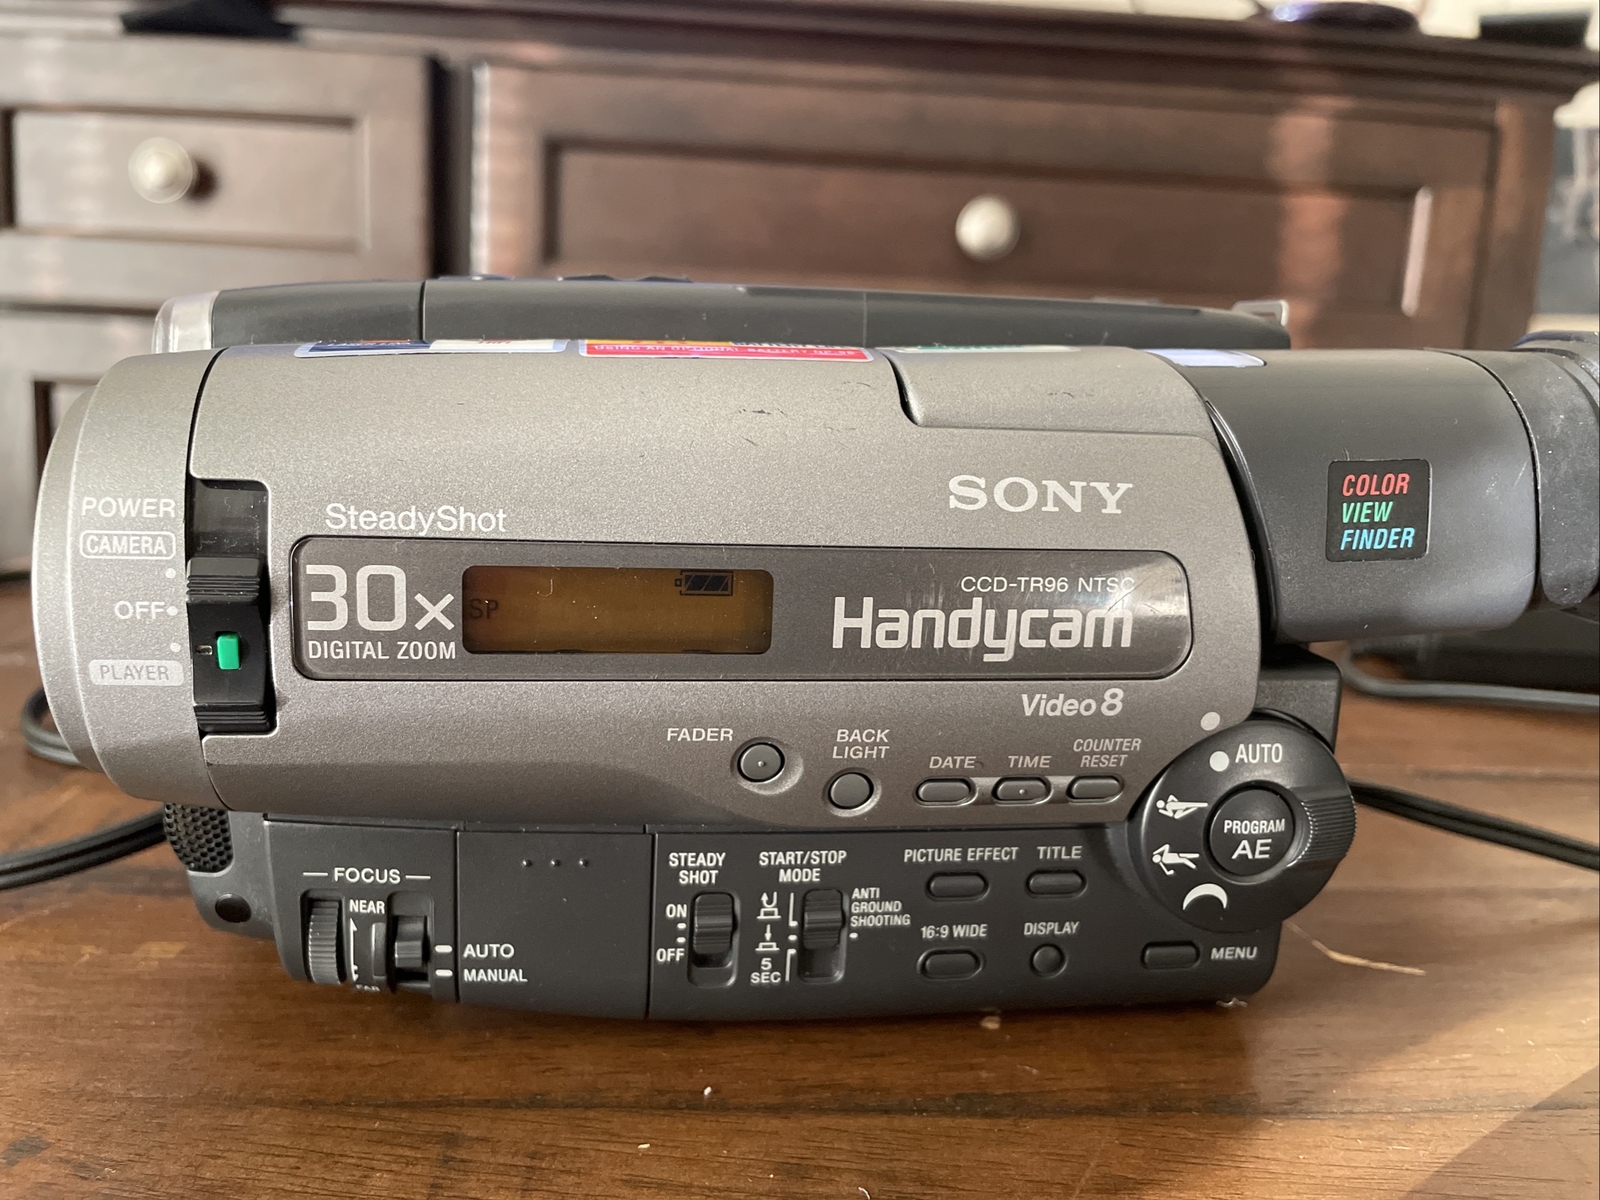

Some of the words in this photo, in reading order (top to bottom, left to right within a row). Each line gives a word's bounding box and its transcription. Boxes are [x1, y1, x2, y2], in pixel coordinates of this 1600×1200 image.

[1342, 473, 1410, 497] COLOR
[948, 475, 1134, 514] SONY
[81, 496, 177, 518] POWER
[1342, 501, 1393, 523] VIEW
[325, 502, 507, 536] SteadyShot
[86, 535, 167, 555] CAMERA
[1340, 527, 1415, 550] FINDER
[960, 576, 1069, 593] CCD-TR96
[1078, 577, 1135, 593] NTSC
[114, 601, 166, 620] OFF
[469, 598, 499, 620] SP
[832, 596, 1134, 662] Handycam
[308, 640, 390, 660] DIGITAL
[397, 641, 457, 660] ZOOM
[99, 665, 170, 681] PLAYER
[666, 727, 734, 742] FADER
[836, 728, 890, 743] BACK
[832, 745, 890, 760] LIGHT
[1072, 738, 1142, 752] COUNTER
[1080, 754, 1128, 768] RESET
[1235, 743, 1284, 764] AUTO
[929, 755, 977, 769] DATE
[1007, 755, 1051, 769] TIME
[1223, 819, 1286, 835] PROGRAM
[904, 848, 963, 863] PICTURE
[967, 847, 1019, 861] EFFECT
[1037, 846, 1083, 861] TITLE
[1231, 838, 1273, 860] AE
[668, 852, 726, 868] STEADY
[758, 850, 848, 867] START/STOP
[334, 867, 401, 885] FOCUS
[678, 869, 719, 885] SHOT
[778, 868, 821, 883] MODE
[852, 887, 880, 900] ANTI
[349, 899, 385, 915] NEAR
[665, 904, 688, 919] ON
[851, 901, 902, 914] GROUND
[850, 914, 912, 928] SHOOTING
[920, 925, 950, 940] 16:9
[952, 924, 988, 938] WIDE
[1023, 922, 1080, 937] DISPLAY
[463, 943, 515, 959] AUTO
[656, 948, 685, 963] OFF
[1210, 947, 1258, 961] MENU
[760, 958, 772, 971] 5
[463, 968, 528, 983] MANUAL
[750, 972, 781, 984] SEC
